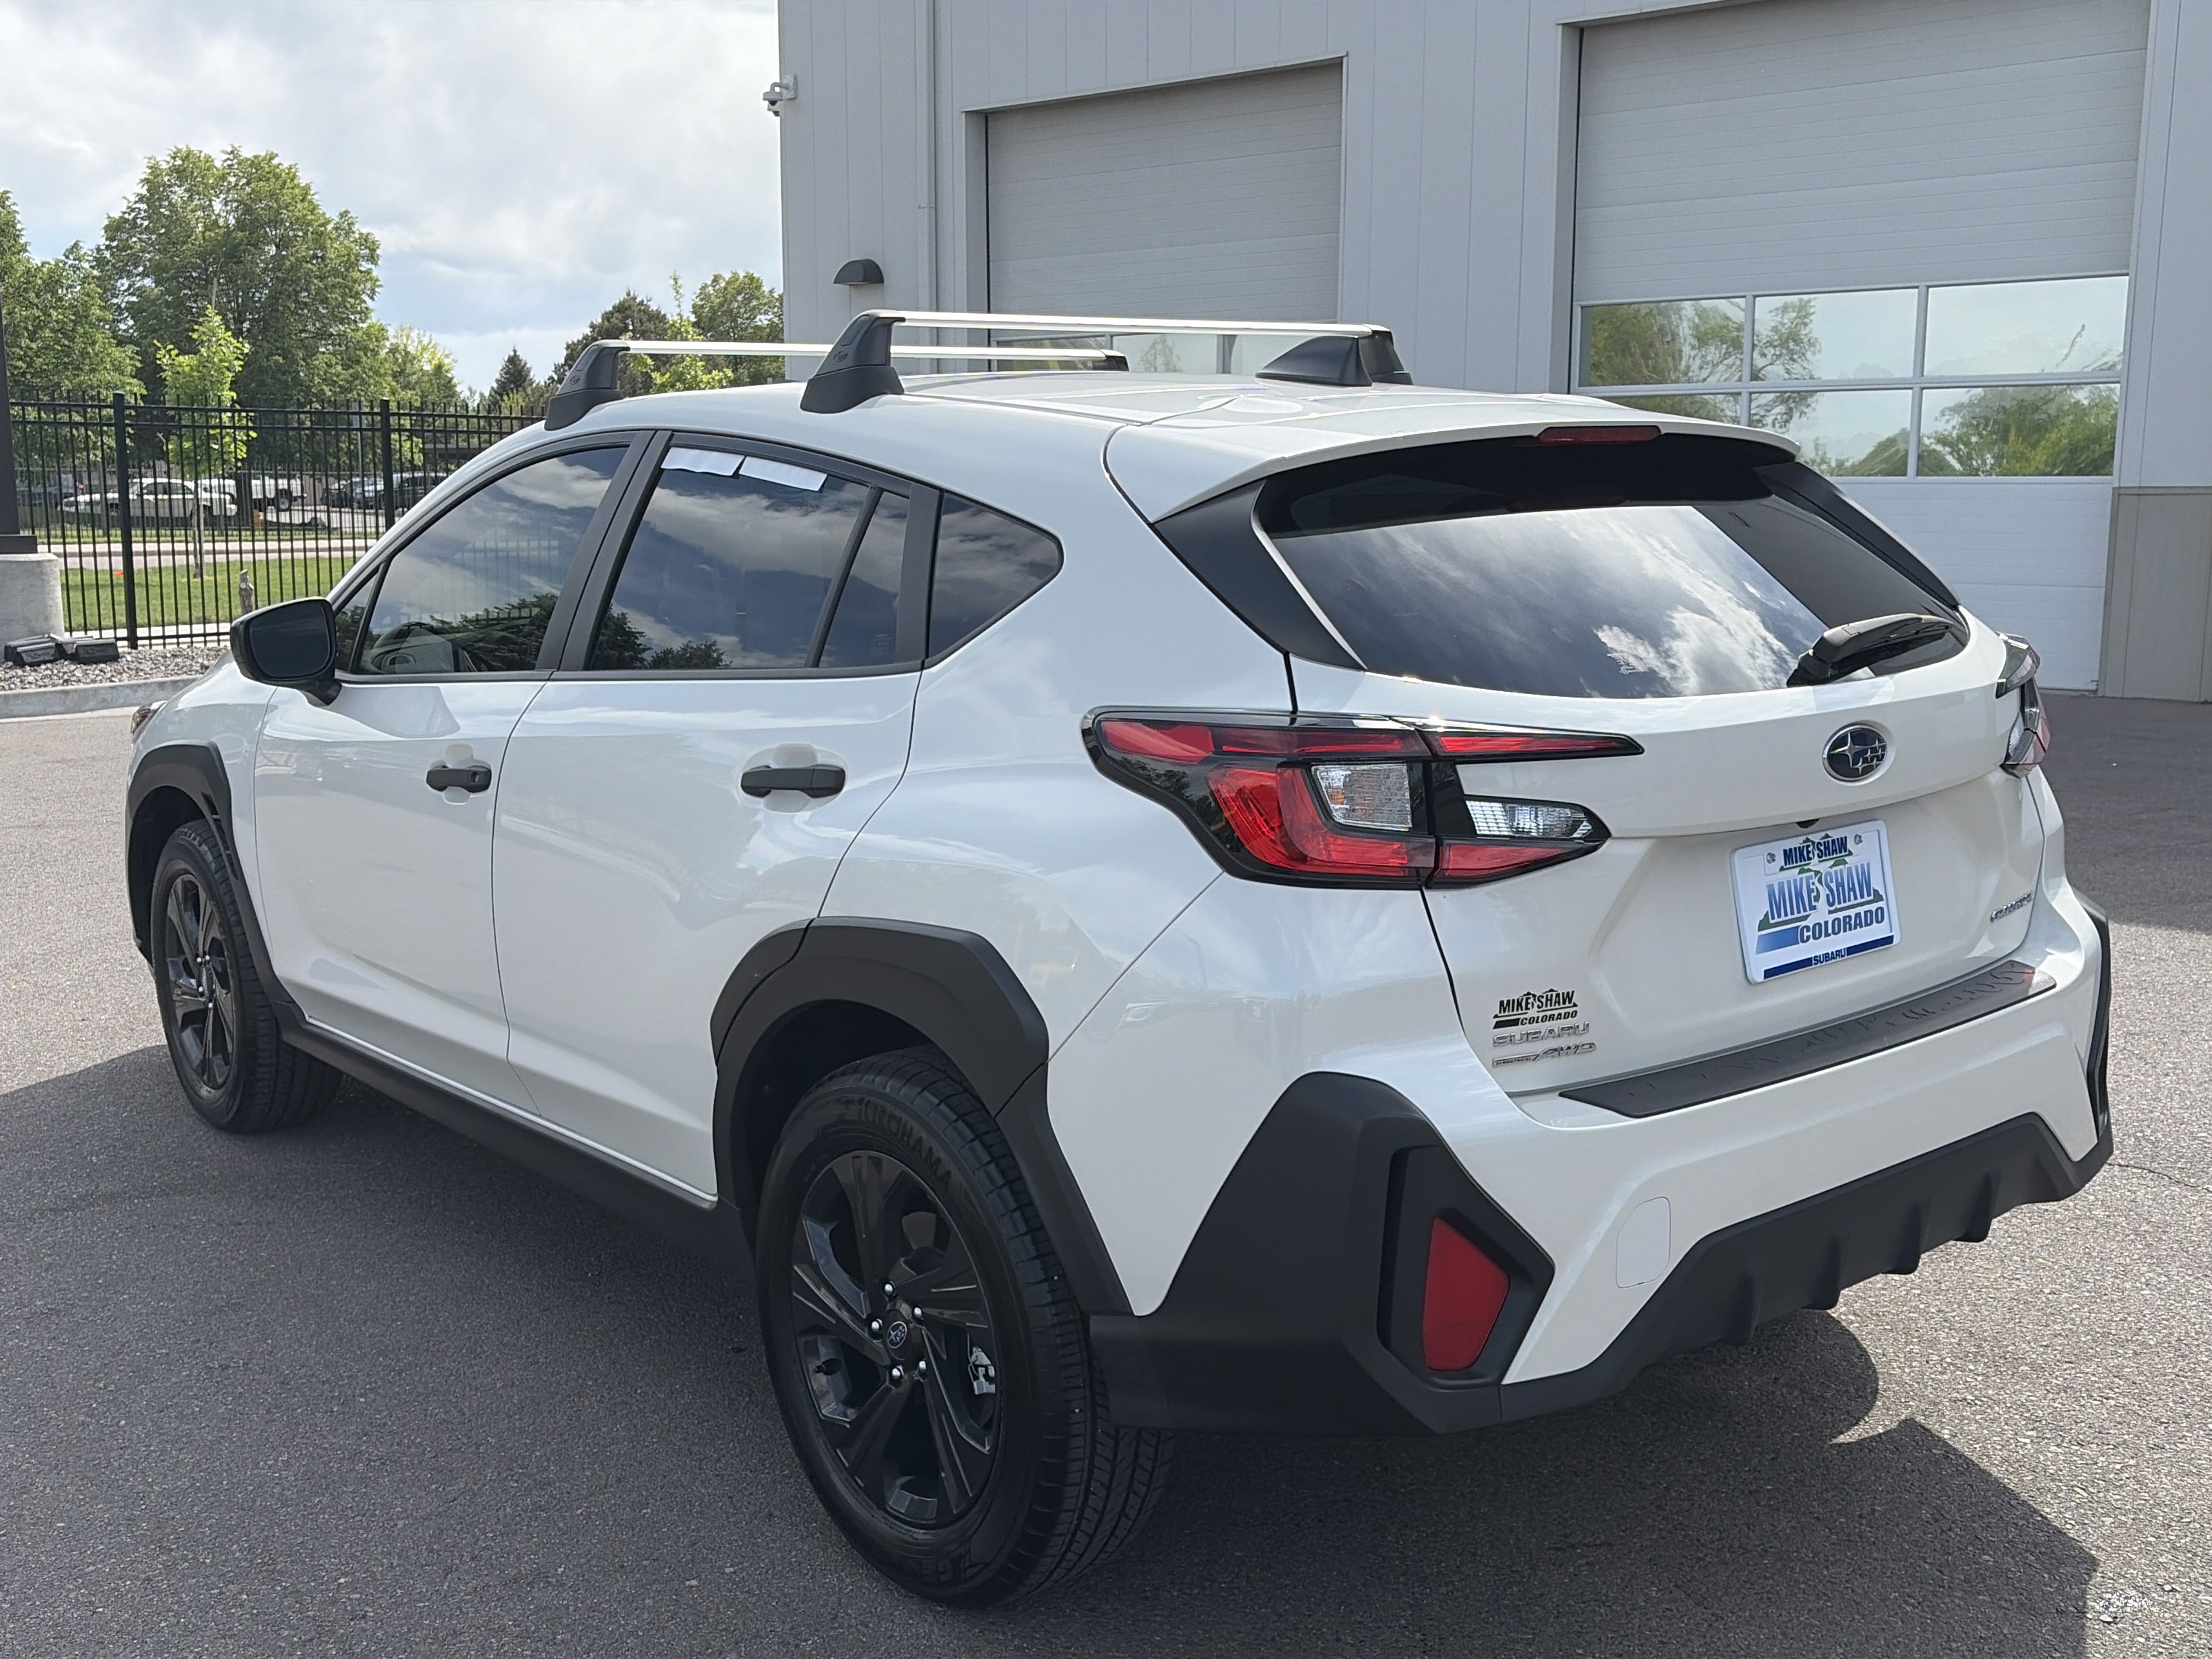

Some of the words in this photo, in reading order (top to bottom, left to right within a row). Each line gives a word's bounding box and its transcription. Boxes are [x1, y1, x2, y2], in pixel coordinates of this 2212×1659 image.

[1783, 845, 1812, 866] MIKE
[1816, 836, 1848, 859] SHAW
[1767, 874, 1816, 920] MIKE
[1823, 862, 1871, 907] SHAW
[1799, 906, 1885, 944] COLORADO
[1813, 947, 1847, 965] SUBARU
[1499, 997, 1531, 1014] MIKE
[1537, 990, 1575, 1009] SHAW
[1520, 1010, 1578, 1026] COLORADO
[1493, 1022, 1590, 1047] SUBARU
[1534, 1041, 1597, 1061] AWD
